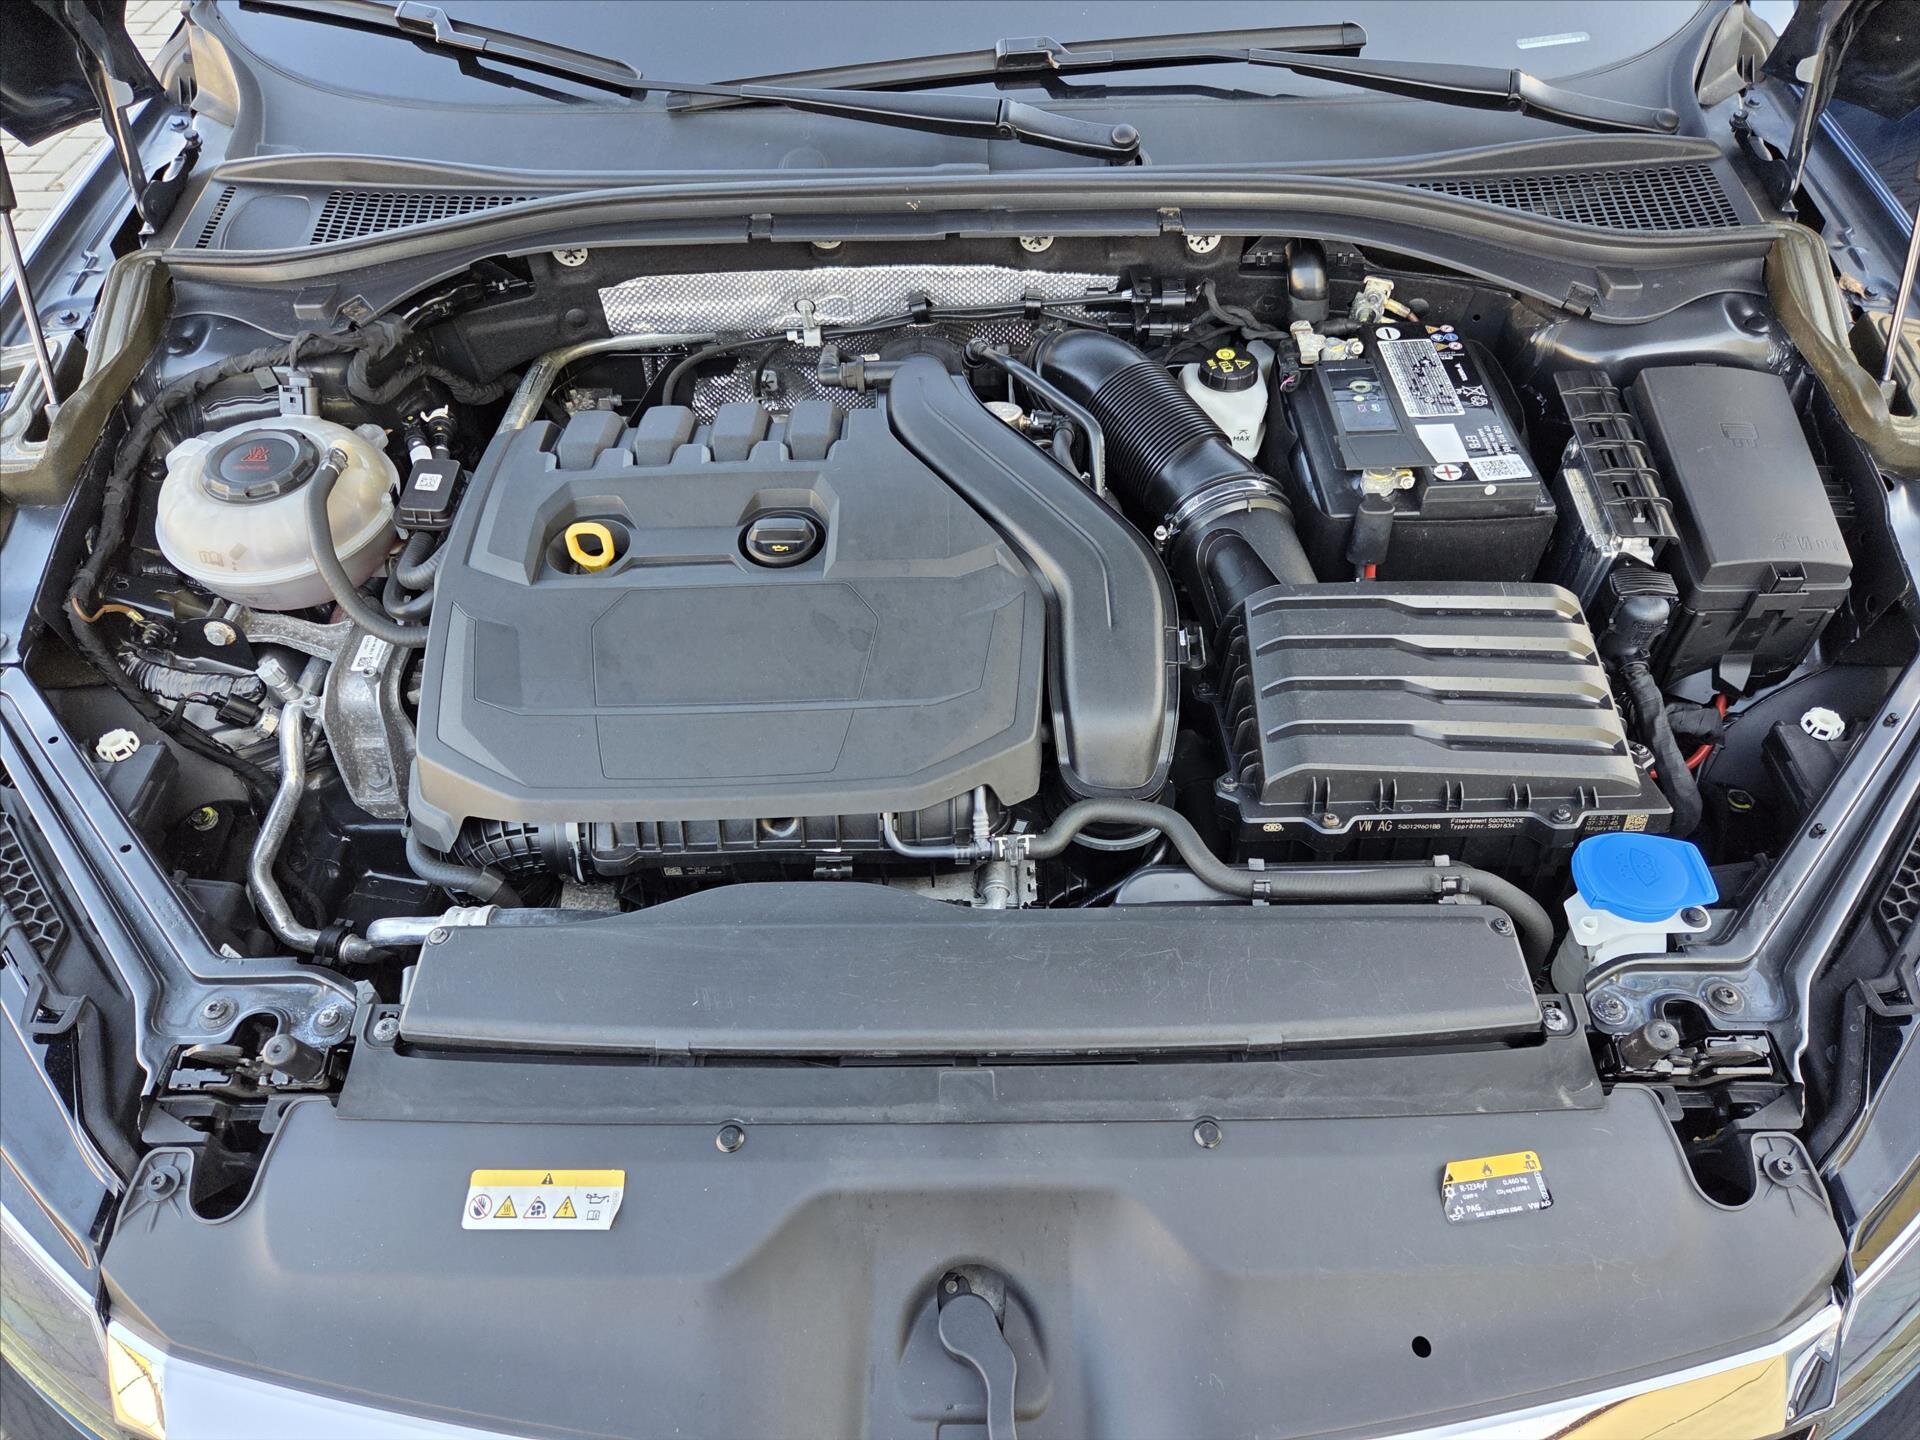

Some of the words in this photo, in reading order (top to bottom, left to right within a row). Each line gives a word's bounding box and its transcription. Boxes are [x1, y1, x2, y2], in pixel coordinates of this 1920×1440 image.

[1465, 435, 1481, 448] EFB
[1358, 821, 1374, 832] VW
[1377, 820, 1393, 832] AG
[1459, 1180, 1488, 1192] R-1234yf
[1466, 1204, 1481, 1212] PAG
[1528, 1201, 1540, 1209] VW
[1541, 1200, 1551, 1208] AG
